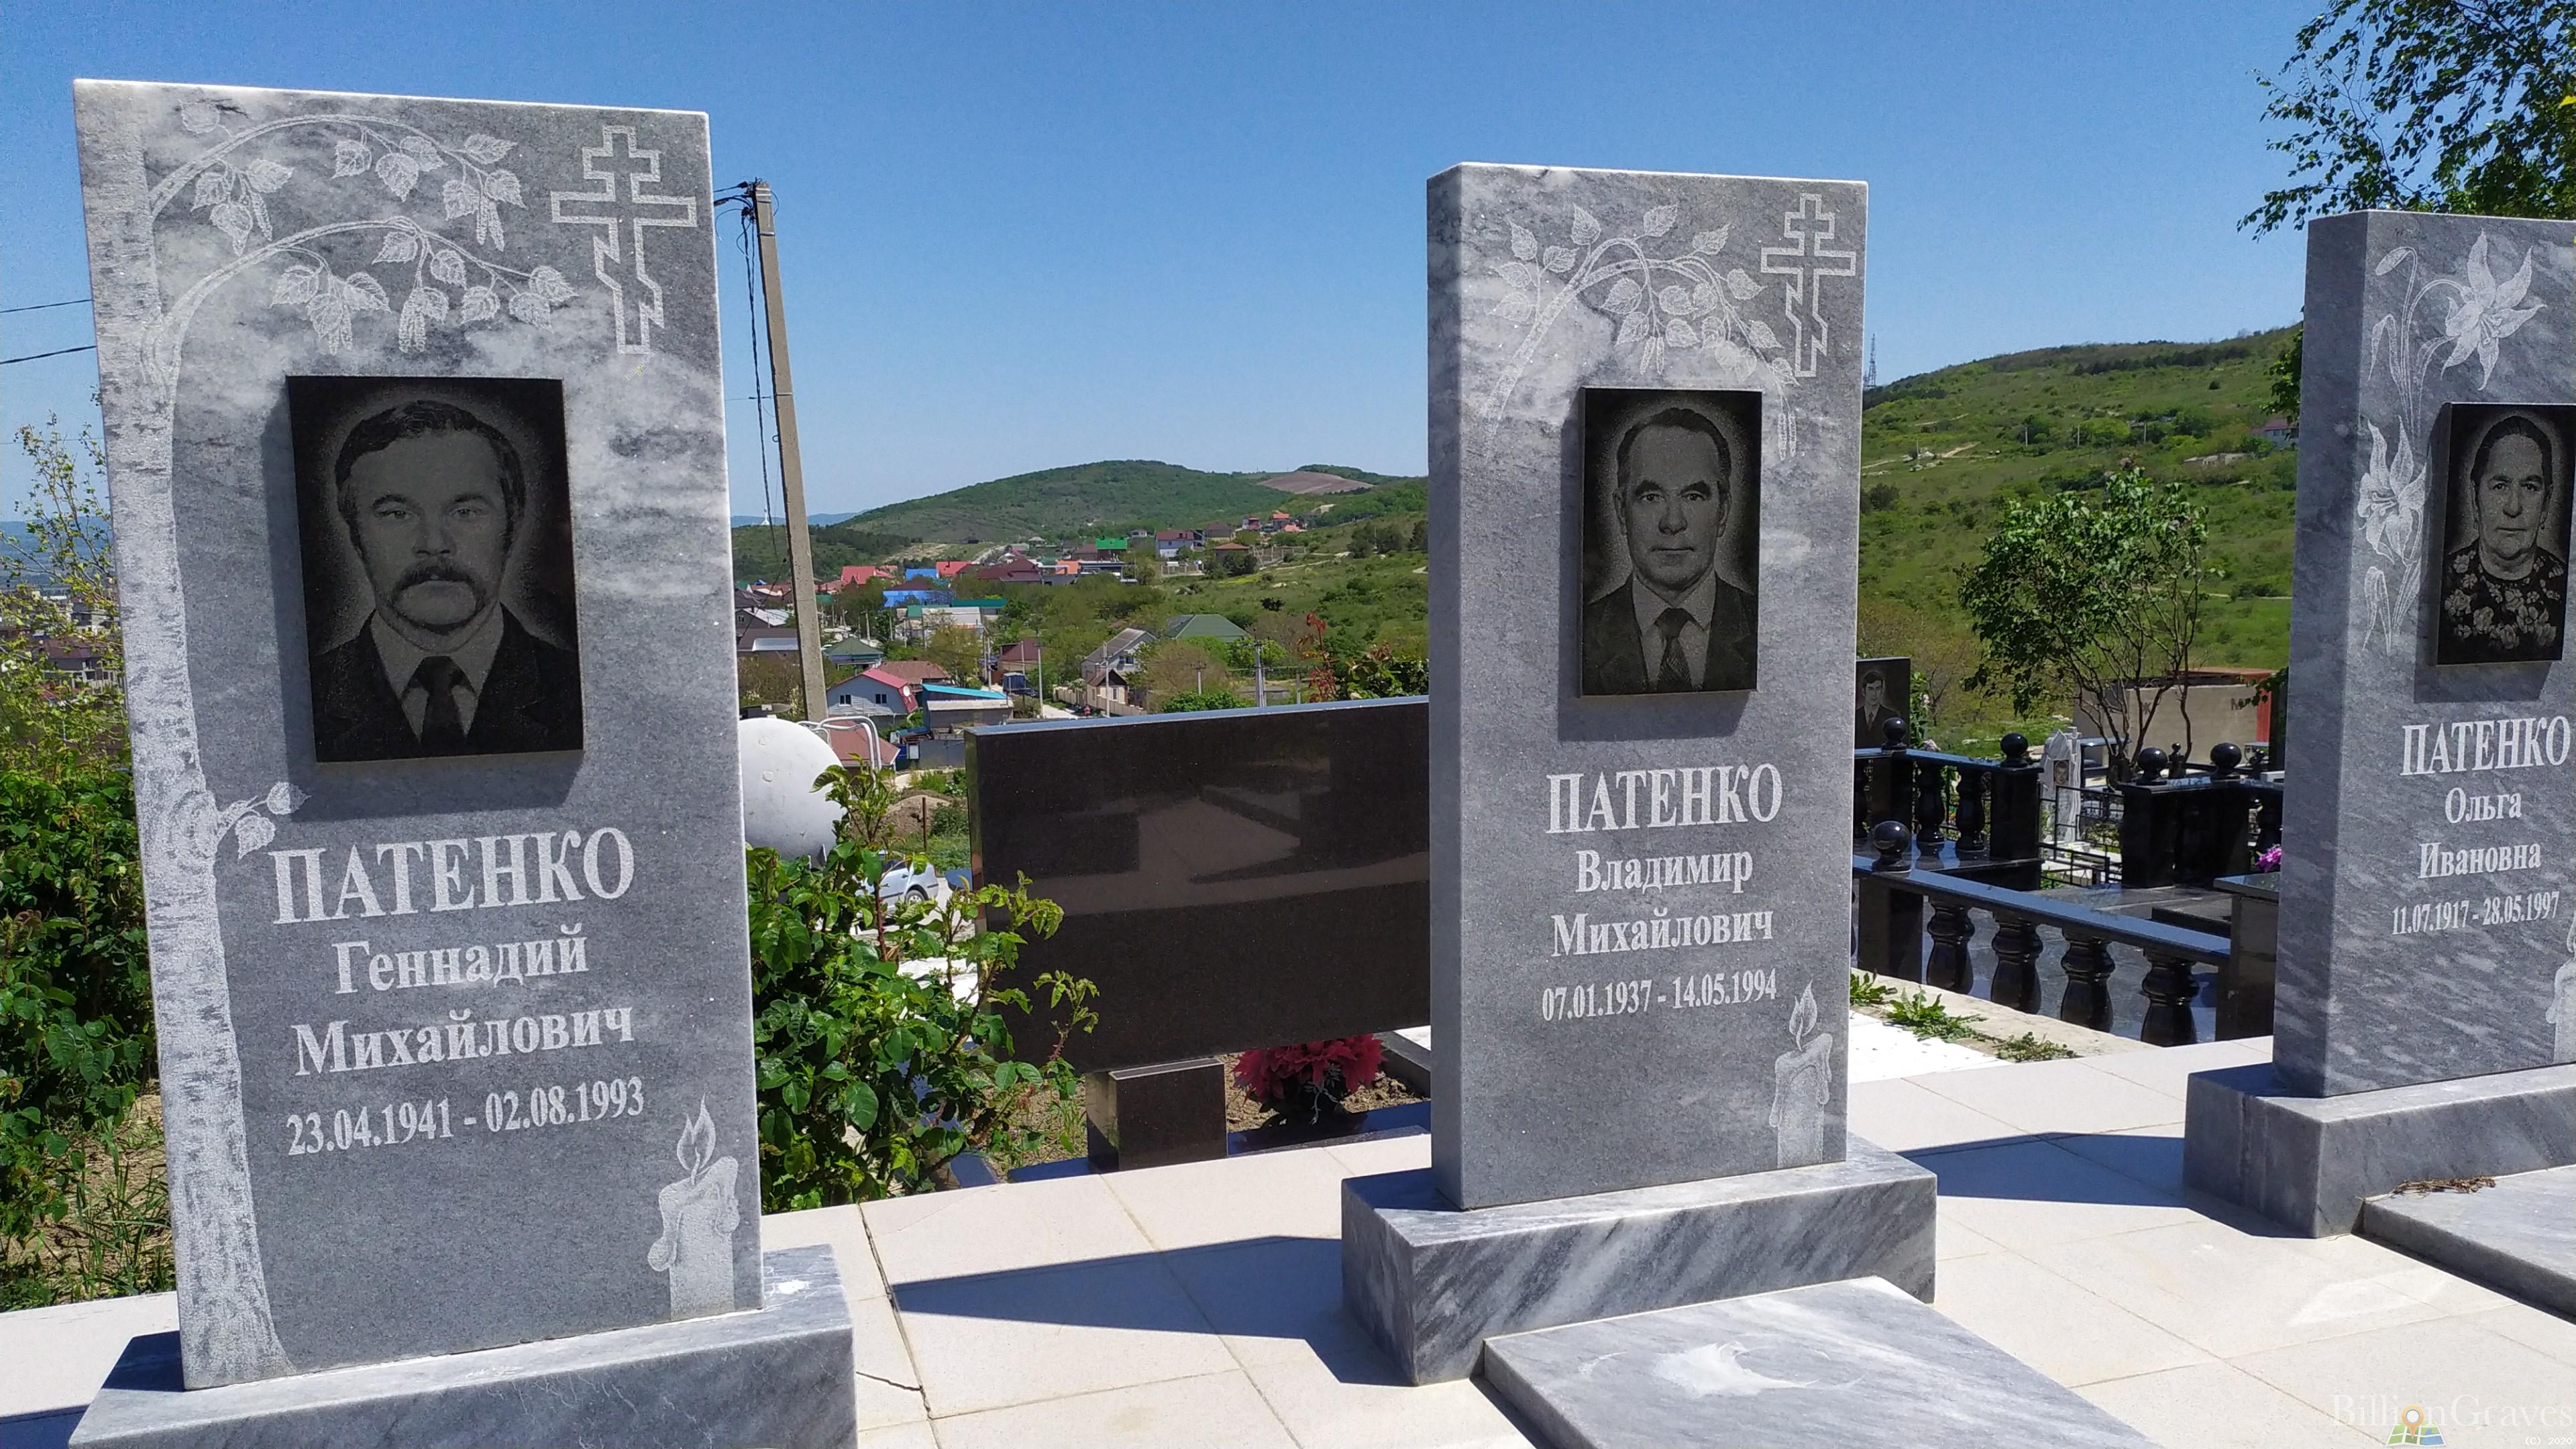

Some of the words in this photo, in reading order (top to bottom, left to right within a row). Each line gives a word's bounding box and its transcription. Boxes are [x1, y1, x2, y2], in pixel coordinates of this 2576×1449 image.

[2400, 715, 2571, 775] ПАТЕНКО
[1545, 763, 1783, 833] ПАТЕНКО
[2445, 787, 2522, 824] Ольга
[269, 826, 635, 924] ПАТЕНКО
[1575, 850, 1754, 894] Владимир
[2418, 842, 2541, 879] Ивановна
[1550, 907, 1773, 957] Михайлович
[2392, 900, 2470, 935] 11.07.1917
[2482, 891, 2560, 926] 28.05.1997
[331, 922, 589, 994] Геннадий
[1542, 979, 1652, 1021] 07.01.1937
[1672, 967, 1777, 1009] 14.05.1994
[290, 1007, 635, 1076] Михайлович
[286, 1096, 454, 1155] 23.04.1941
[485, 1076, 645, 1132] 02.08.1993
